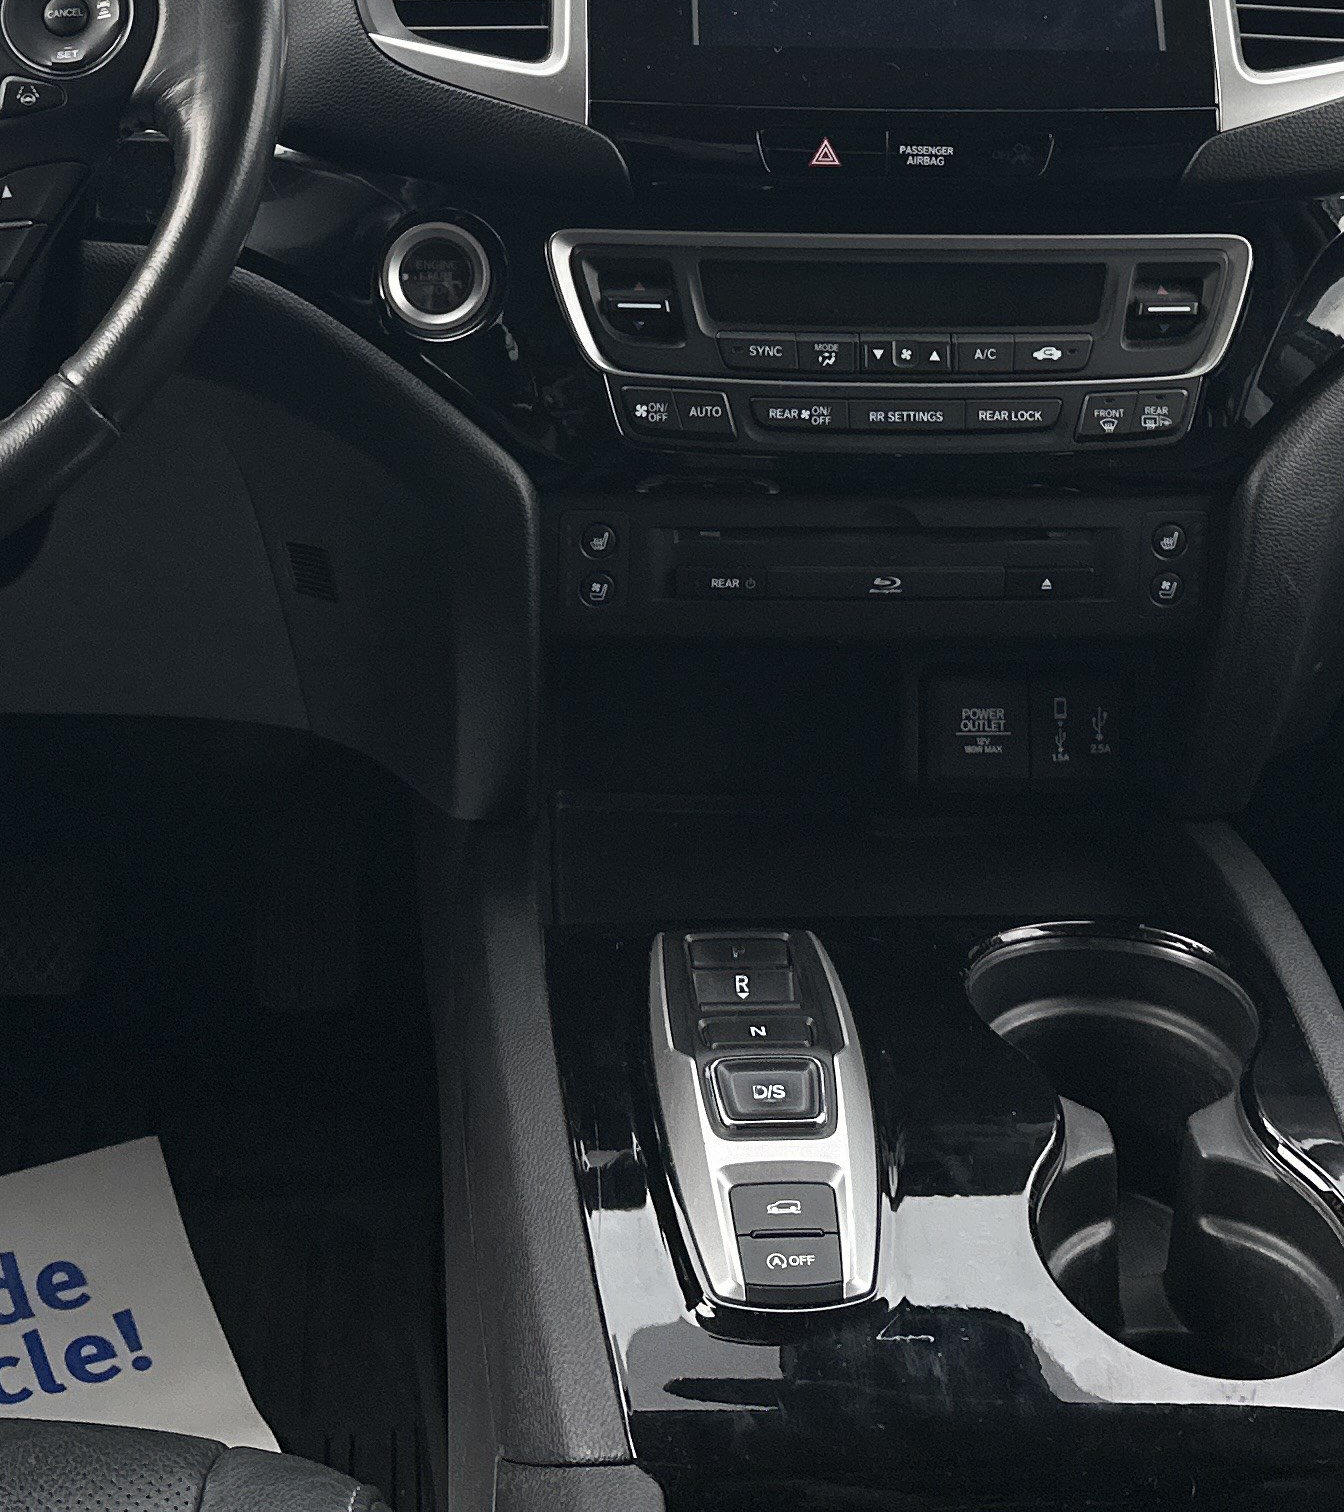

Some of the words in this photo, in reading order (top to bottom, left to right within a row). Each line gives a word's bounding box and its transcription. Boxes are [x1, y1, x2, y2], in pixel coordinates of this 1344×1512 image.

[47, 8, 84, 19] CANCEL
[56, 49, 79, 59] SET
[899, 145, 954, 155] PASSENGER
[906, 155, 945, 166] AIRBAG
[749, 345, 783, 357] SYNC
[814, 343, 840, 353] MODE
[974, 348, 997, 360] A/C
[648, 402, 668, 412] ON/
[689, 405, 722, 417] AUTO
[811, 405, 831, 416] ON/
[1144, 406, 1169, 415] REAR
[648, 412, 668, 422] OFF
[769, 408, 799, 419] REAR
[869, 411, 885, 422] RR
[887, 411, 944, 423] SETTINGS
[978, 410, 1010, 421] REAR
[1011, 410, 1042, 421] LOCK
[1094, 408, 1124, 419] FRONT
[811, 416, 832, 425] OFF
[711, 578, 740, 588] REAR
[961, 708, 1005, 720] POWER
[960, 720, 1006, 731] OUTLET
[984, 745, 1003, 753] MAX
[1090, 744, 1111, 753] 2.5A
[735, 975, 749, 993] R
[749, 1025, 767, 1037] N
[752, 1084, 786, 1100] D/S
[789, 1254, 816, 1266] OFF
